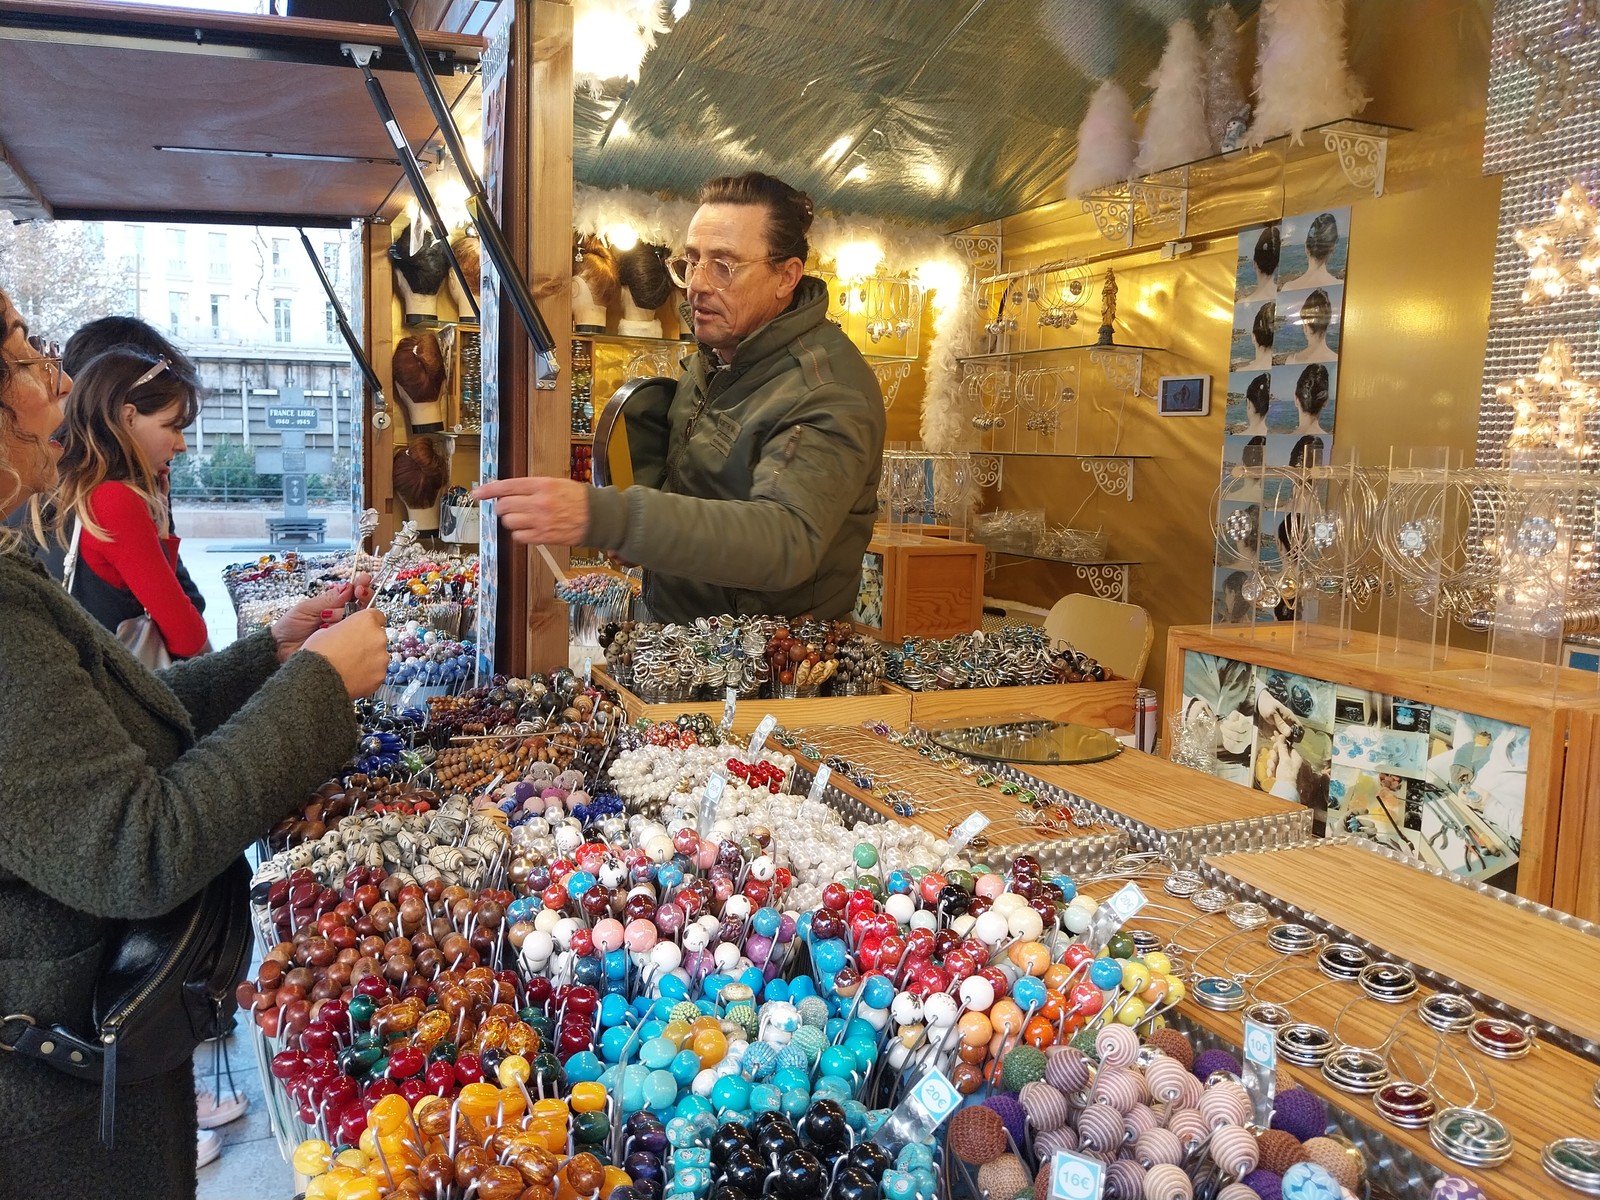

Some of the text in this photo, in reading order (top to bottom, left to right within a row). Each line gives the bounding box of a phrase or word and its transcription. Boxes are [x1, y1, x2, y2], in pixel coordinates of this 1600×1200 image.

[270, 409, 316, 417] FRANCE LIBRE
[1120, 894, 1135, 910] 20€
[1250, 1038, 1268, 1055] 10€
[925, 1084, 947, 1109] 20€
[1063, 1171, 1090, 1190] 16€
